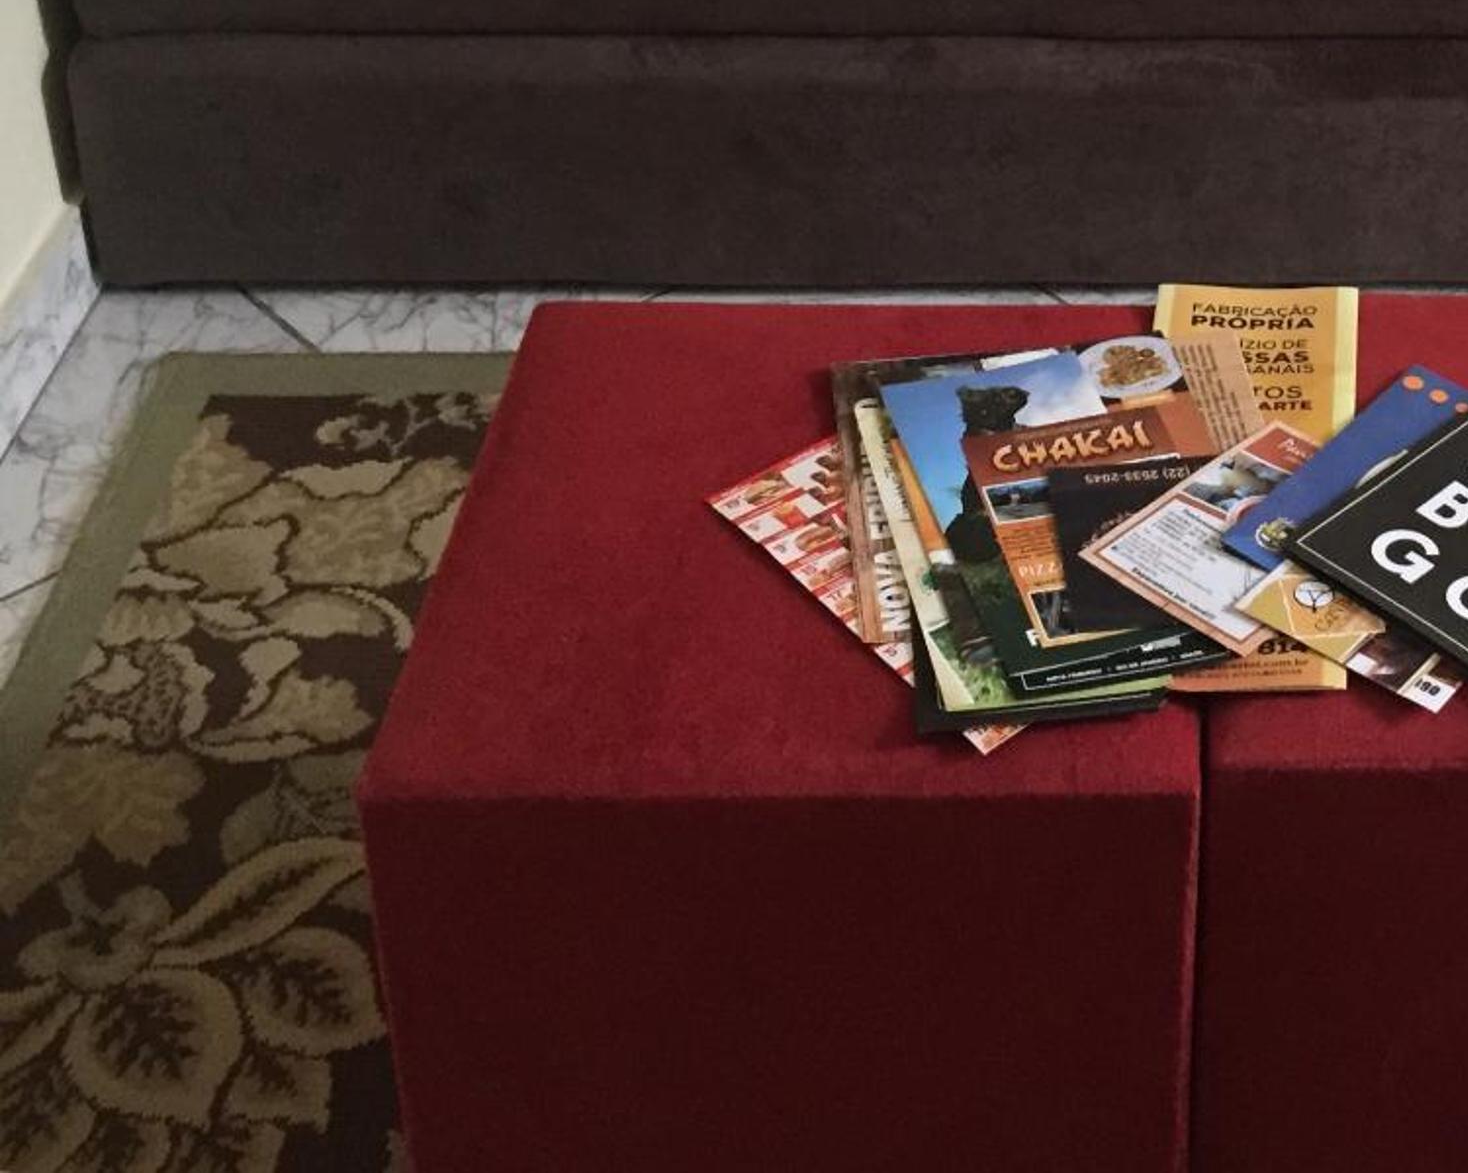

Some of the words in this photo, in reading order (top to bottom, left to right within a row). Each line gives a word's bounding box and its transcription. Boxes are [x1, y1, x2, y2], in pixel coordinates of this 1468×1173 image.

[1192, 302, 1318, 319] FABRICAÇÃO
[1282, 338, 1308, 350] DE
[1242, 350, 1310, 364] SSAS
[1246, 363, 1315, 376] ANAIS
[1253, 385, 1303, 399] TOS
[1258, 399, 1313, 411] ARTE
[992, 420, 1153, 472] CHAKAI
